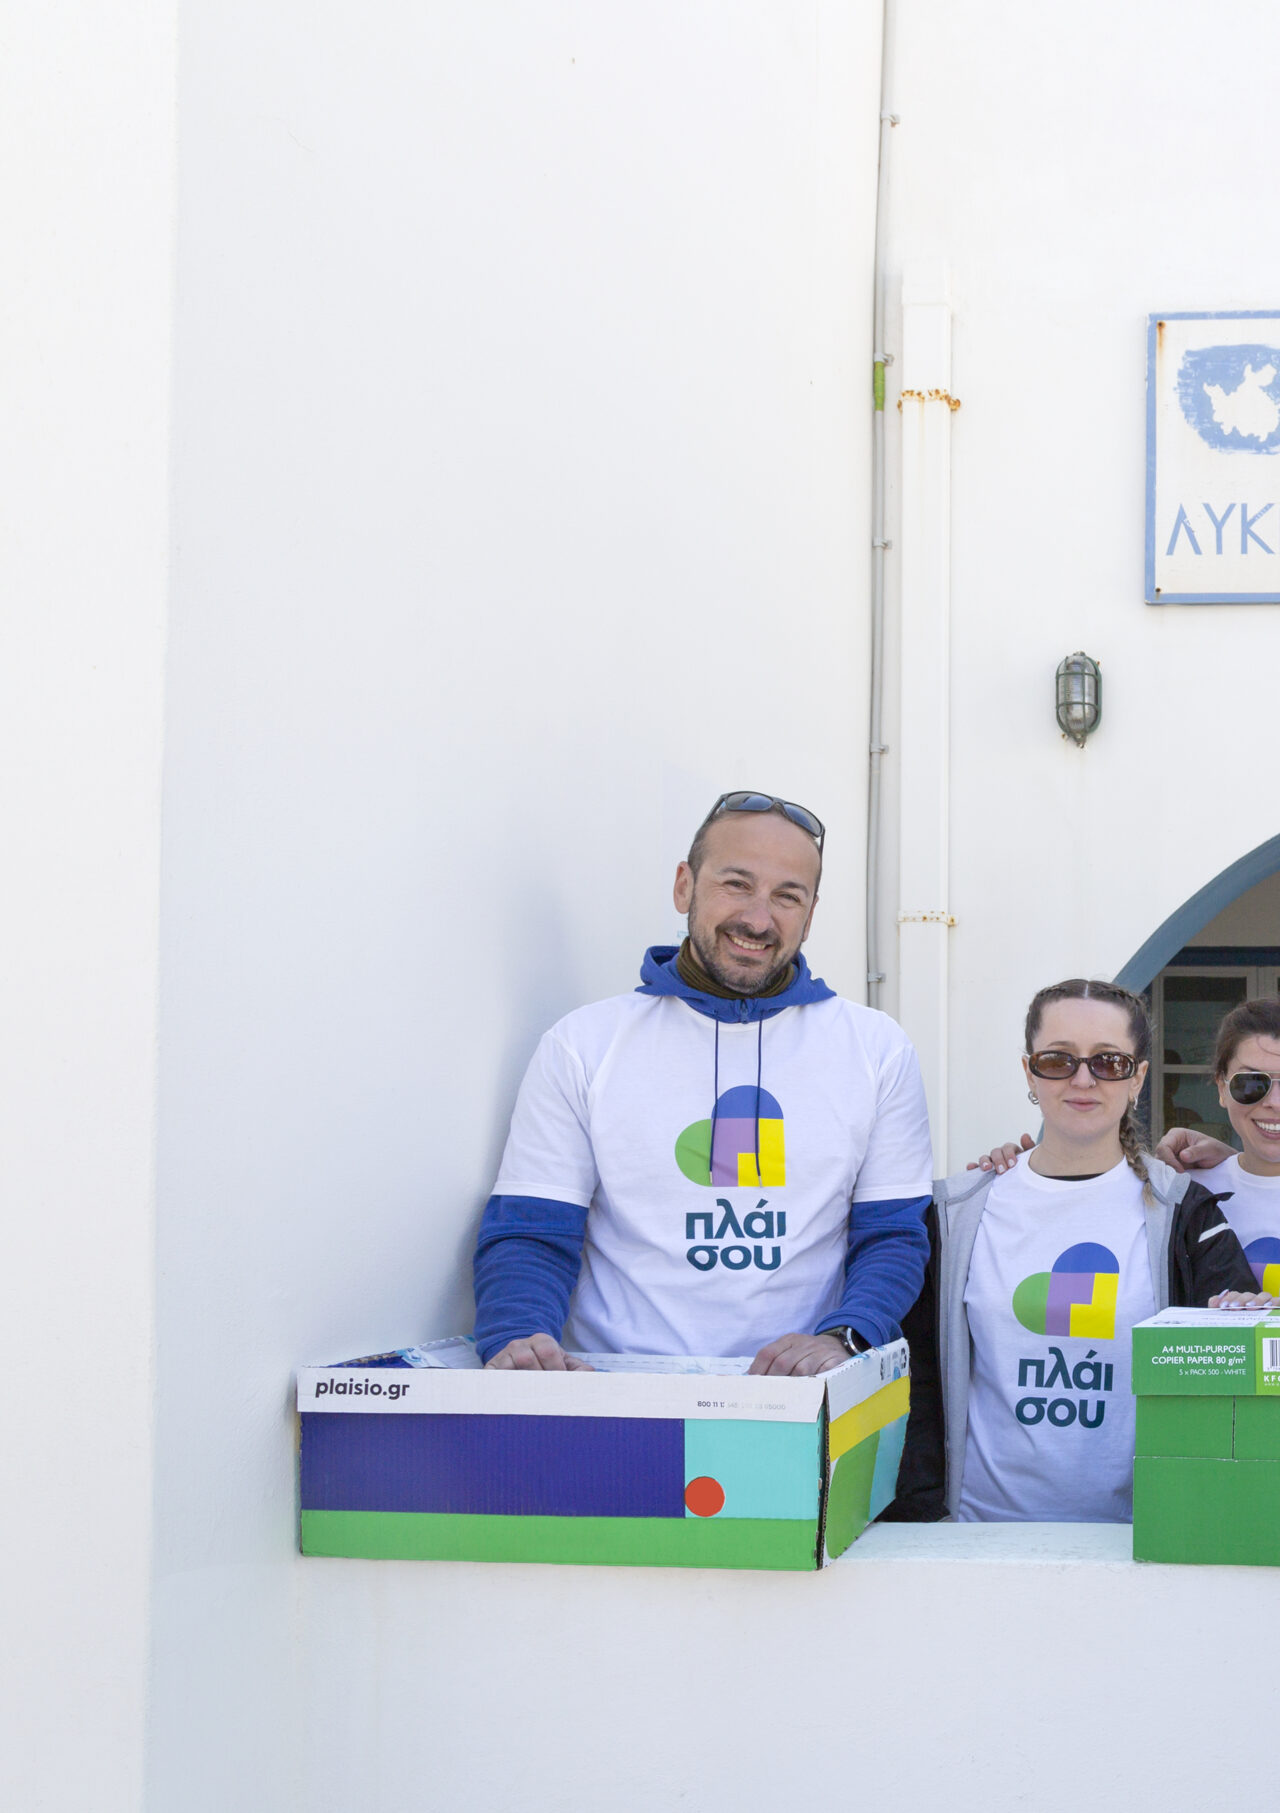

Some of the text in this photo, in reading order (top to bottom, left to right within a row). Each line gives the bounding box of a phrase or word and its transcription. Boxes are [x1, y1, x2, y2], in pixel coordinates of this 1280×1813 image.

[686, 1198, 786, 1240] πλάι
[686, 1245, 781, 1271] σου
[1151, 1356, 1185, 1365] COPIER
[1187, 1356, 1214, 1364] PAPER
[1215, 1356, 1226, 1364] 80
[1162, 1345, 1246, 1354] A4 MULTI-PURPOSE
[1017, 1346, 1114, 1391] πλάι
[1224, 1368, 1246, 1376] WHITE
[315, 1378, 410, 1400] plaisio.gr
[1015, 1397, 1105, 1429] σου
